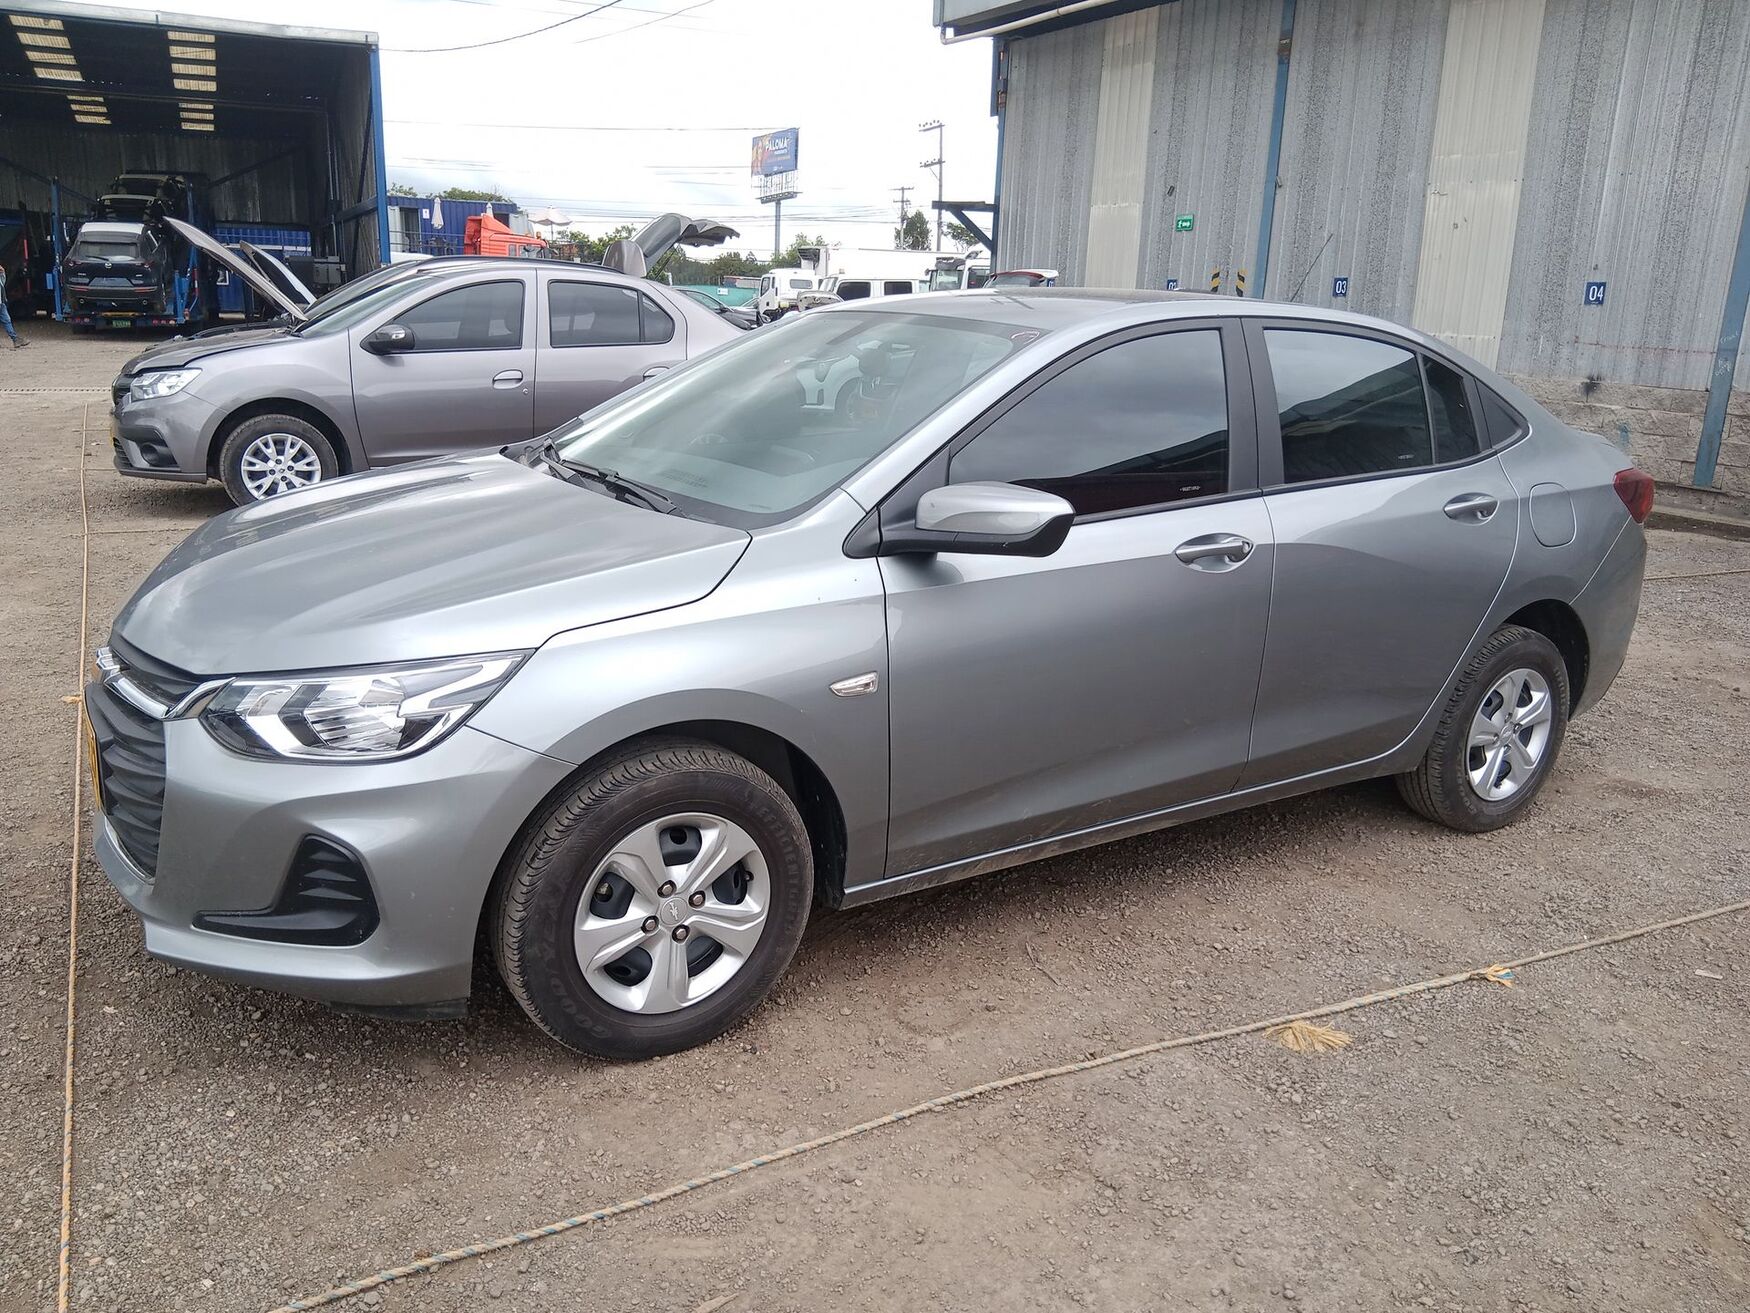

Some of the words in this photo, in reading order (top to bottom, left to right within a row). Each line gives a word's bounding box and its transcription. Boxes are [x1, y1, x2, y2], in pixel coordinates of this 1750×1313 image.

[765, 137, 788, 151] PALOMA
[1335, 280, 1347, 294] 03
[1589, 285, 1604, 301] 04
